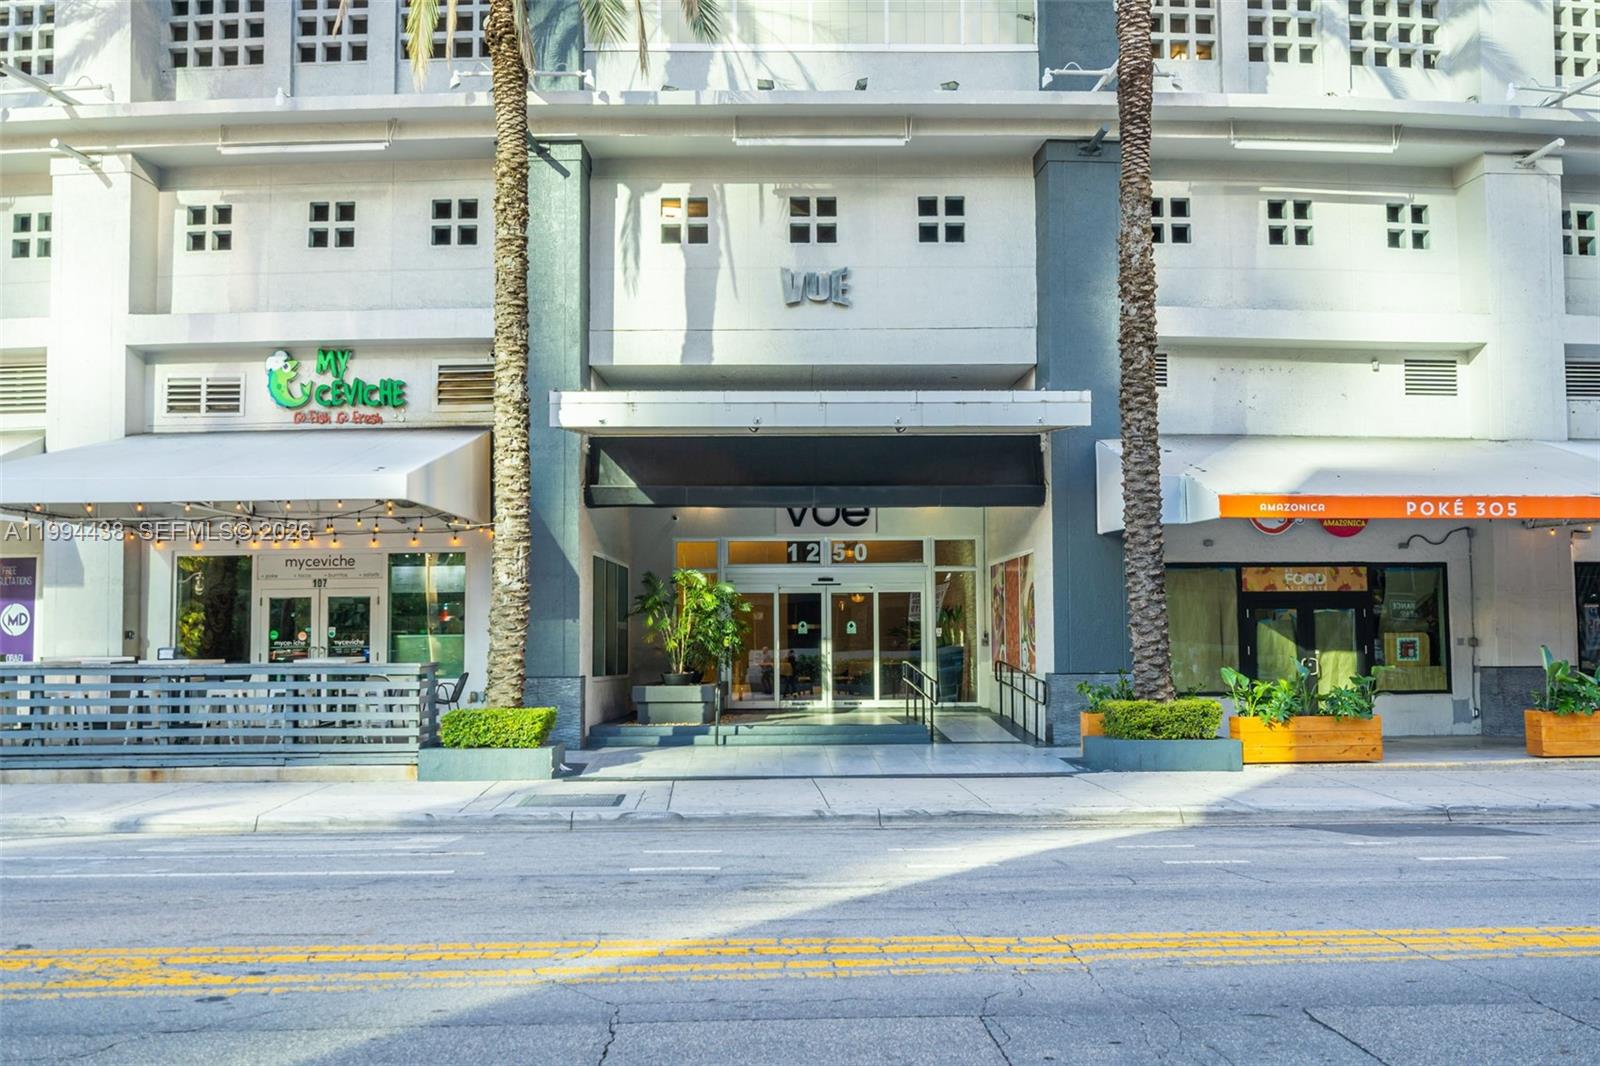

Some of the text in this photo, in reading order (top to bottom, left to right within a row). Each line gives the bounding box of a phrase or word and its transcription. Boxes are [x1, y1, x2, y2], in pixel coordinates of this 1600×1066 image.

[780, 266, 850, 307] VUE
[315, 348, 352, 379] MY
[314, 377, 407, 408] CEVICHE
[1259, 503, 1326, 512] AMAZONICA
[1406, 498, 1518, 516] POKÉ 305
[1322, 519, 1366, 528] AMAZONICA
[284, 554, 356, 571] myceviche
[312, 579, 328, 588] 107
[1284, 573, 1327, 585] FOOD
[7, 612, 28, 626] MD
